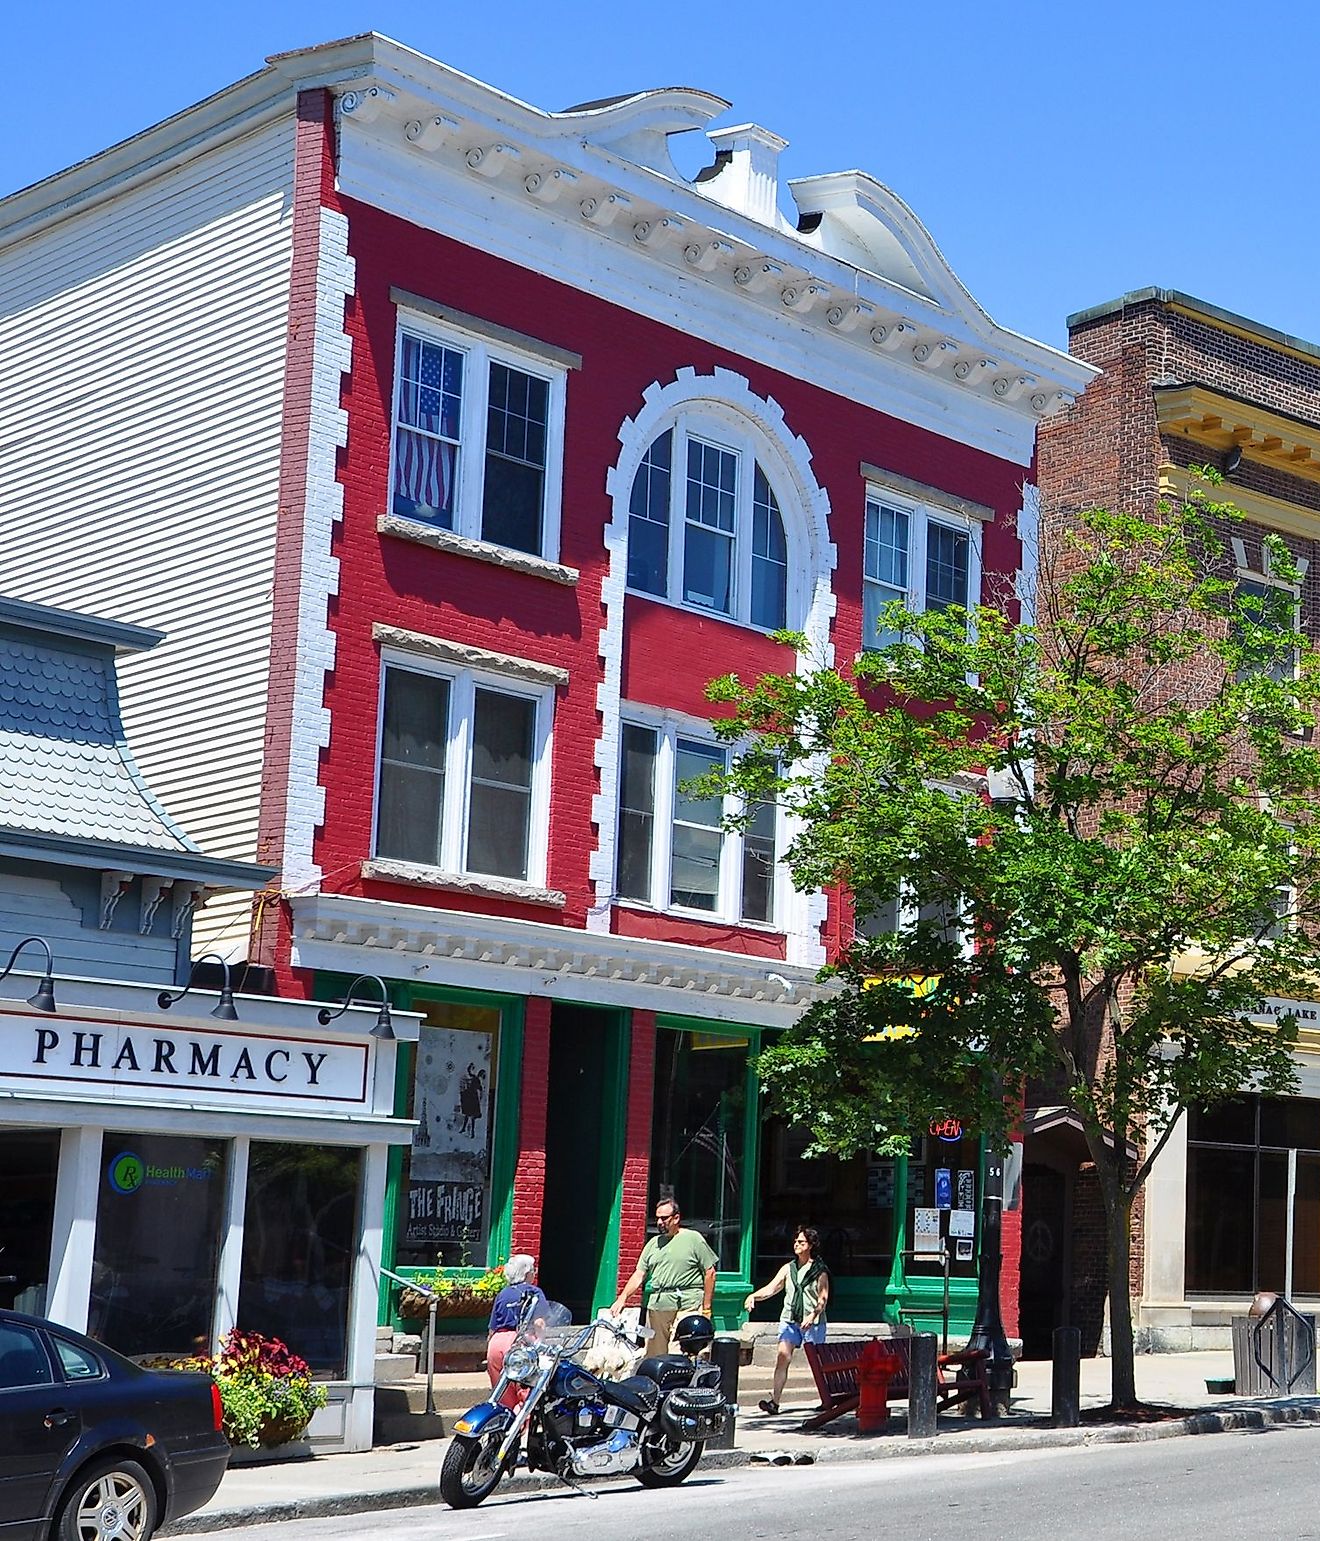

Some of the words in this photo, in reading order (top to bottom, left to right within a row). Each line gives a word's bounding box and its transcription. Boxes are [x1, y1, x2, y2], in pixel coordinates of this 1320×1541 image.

[1287, 1007, 1317, 1020] LAKE
[32, 1028, 328, 1085] PHARMACY
[929, 1119, 960, 1136] OPEN
[409, 1187, 434, 1219] THE
[457, 1225, 481, 1241] Gery
